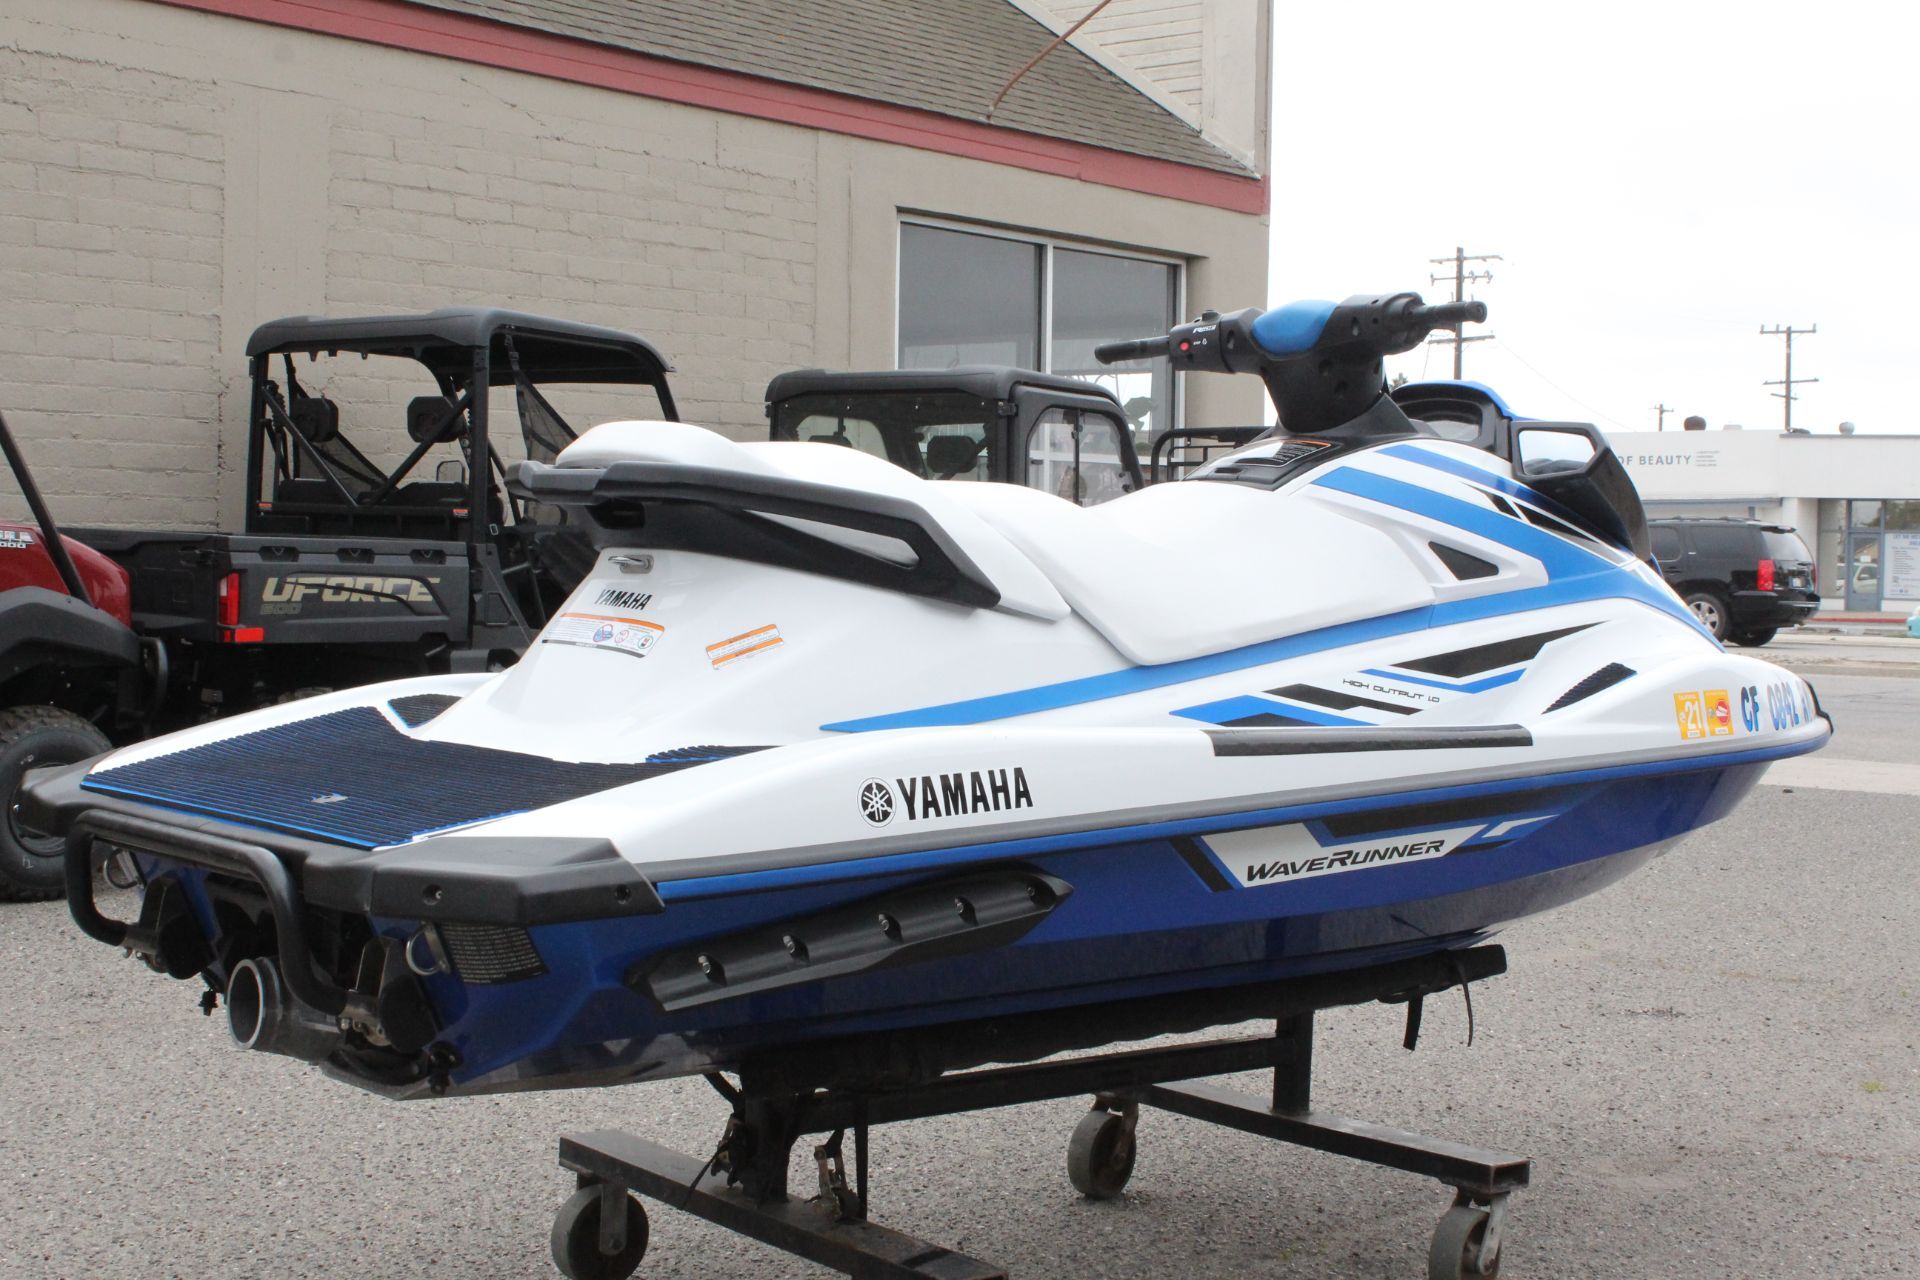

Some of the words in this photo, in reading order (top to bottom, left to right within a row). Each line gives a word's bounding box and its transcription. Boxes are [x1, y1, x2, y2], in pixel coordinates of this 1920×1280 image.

[1639, 455, 1691, 466] BEAUTY
[262, 577, 440, 602] UFORCE
[594, 589, 653, 610] YAMAHA
[1342, 678, 1370, 689] HIGH
[1373, 685, 1424, 700] OUTPUT
[1684, 701, 1702, 730] 21
[1740, 686, 1759, 732] CF
[896, 767, 1033, 821] YAMAHA
